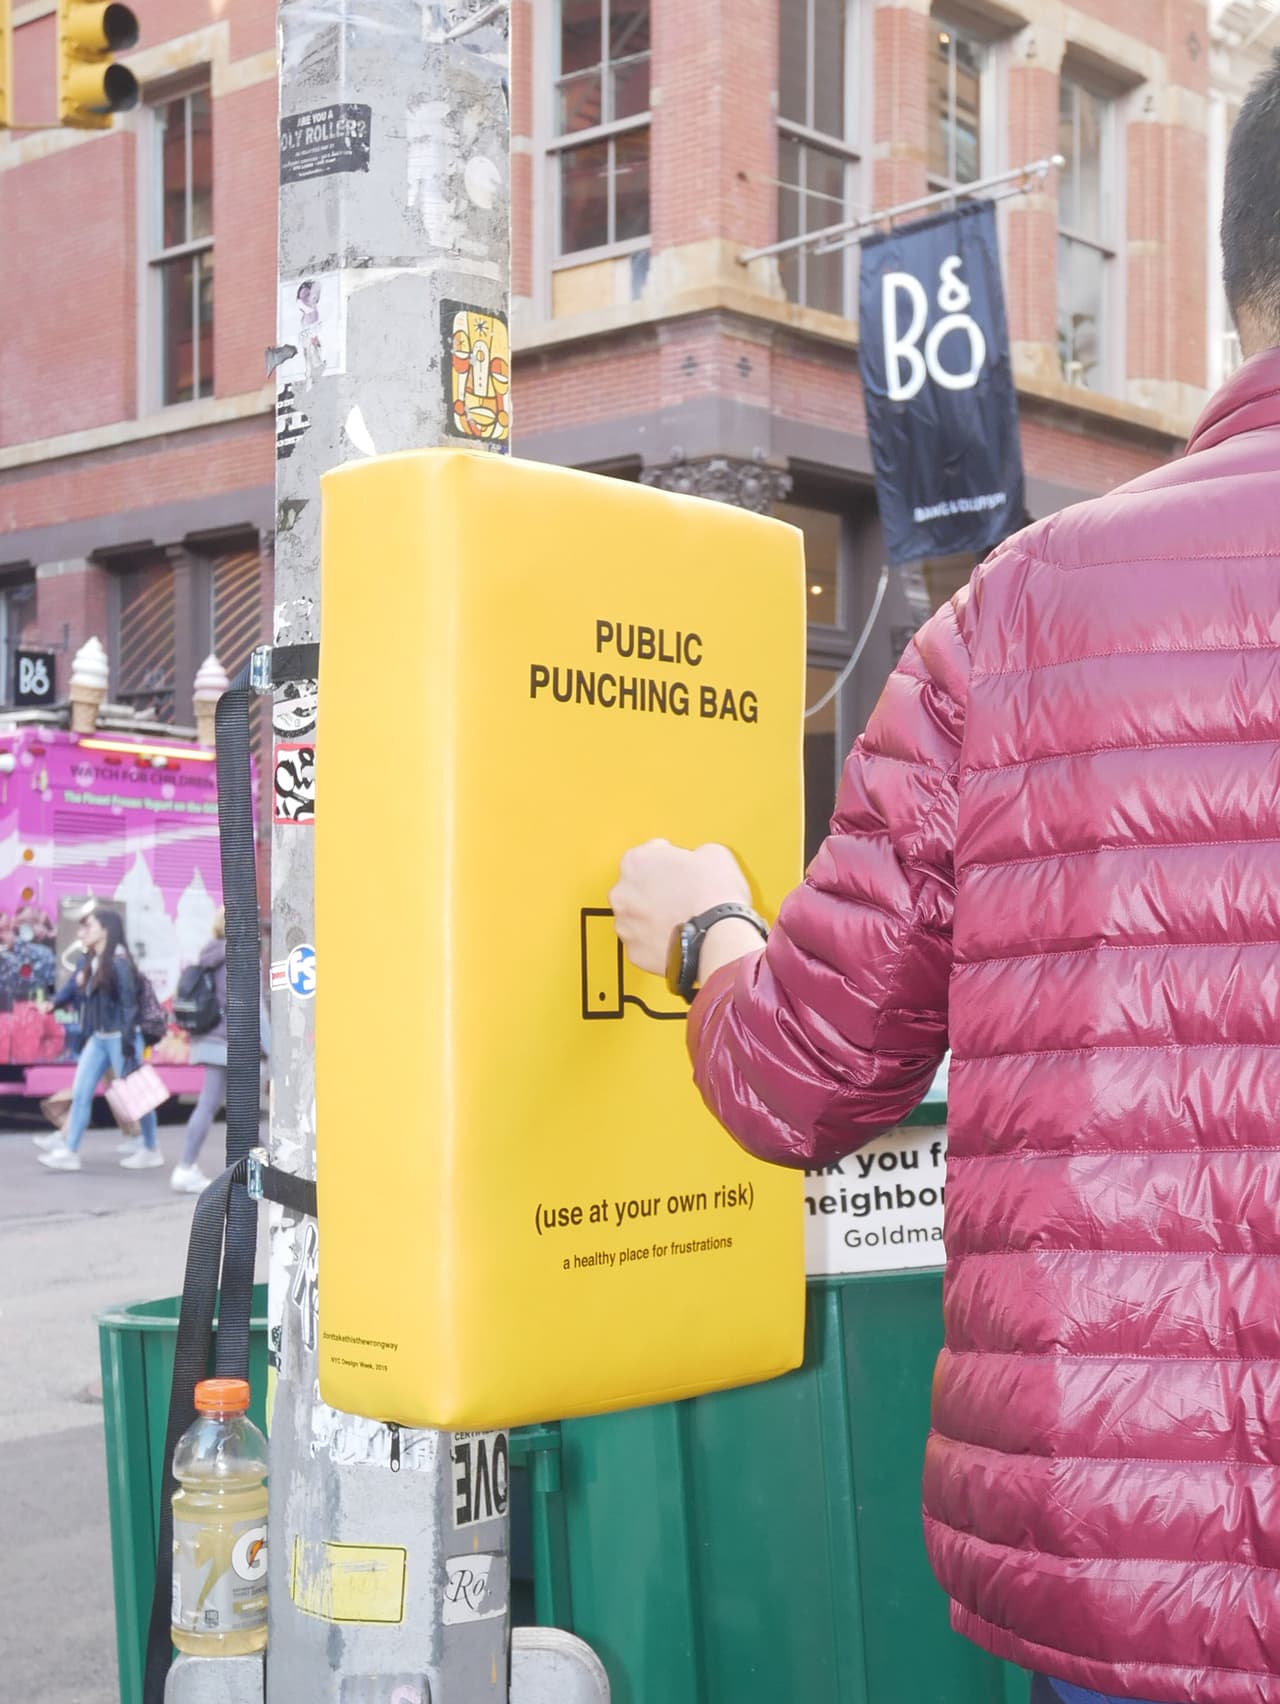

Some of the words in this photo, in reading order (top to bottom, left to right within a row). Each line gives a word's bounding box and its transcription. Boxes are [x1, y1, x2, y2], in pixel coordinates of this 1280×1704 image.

[312, 111, 327, 124] YOU
[328, 109, 335, 120] A
[280, 131, 304, 152] OLY
[595, 619, 703, 667] PUBLIC
[529, 663, 690, 716] PUNCHING
[699, 684, 759, 724] BAG
[70, 764, 119, 782] WATCH
[121, 768, 147, 783] FOR
[856, 1149, 919, 1178] you
[535, 1203, 583, 1236] (use
[589, 1199, 608, 1223] at
[615, 1197, 661, 1227] your
[667, 1191, 707, 1214] own
[714, 1181, 754, 1211] risk)
[563, 1258, 571, 1270] a
[574, 1249, 616, 1268] healthy
[619, 1247, 650, 1266] place
[652, 1243, 669, 1258] for
[671, 1235, 733, 1255] frustrations
